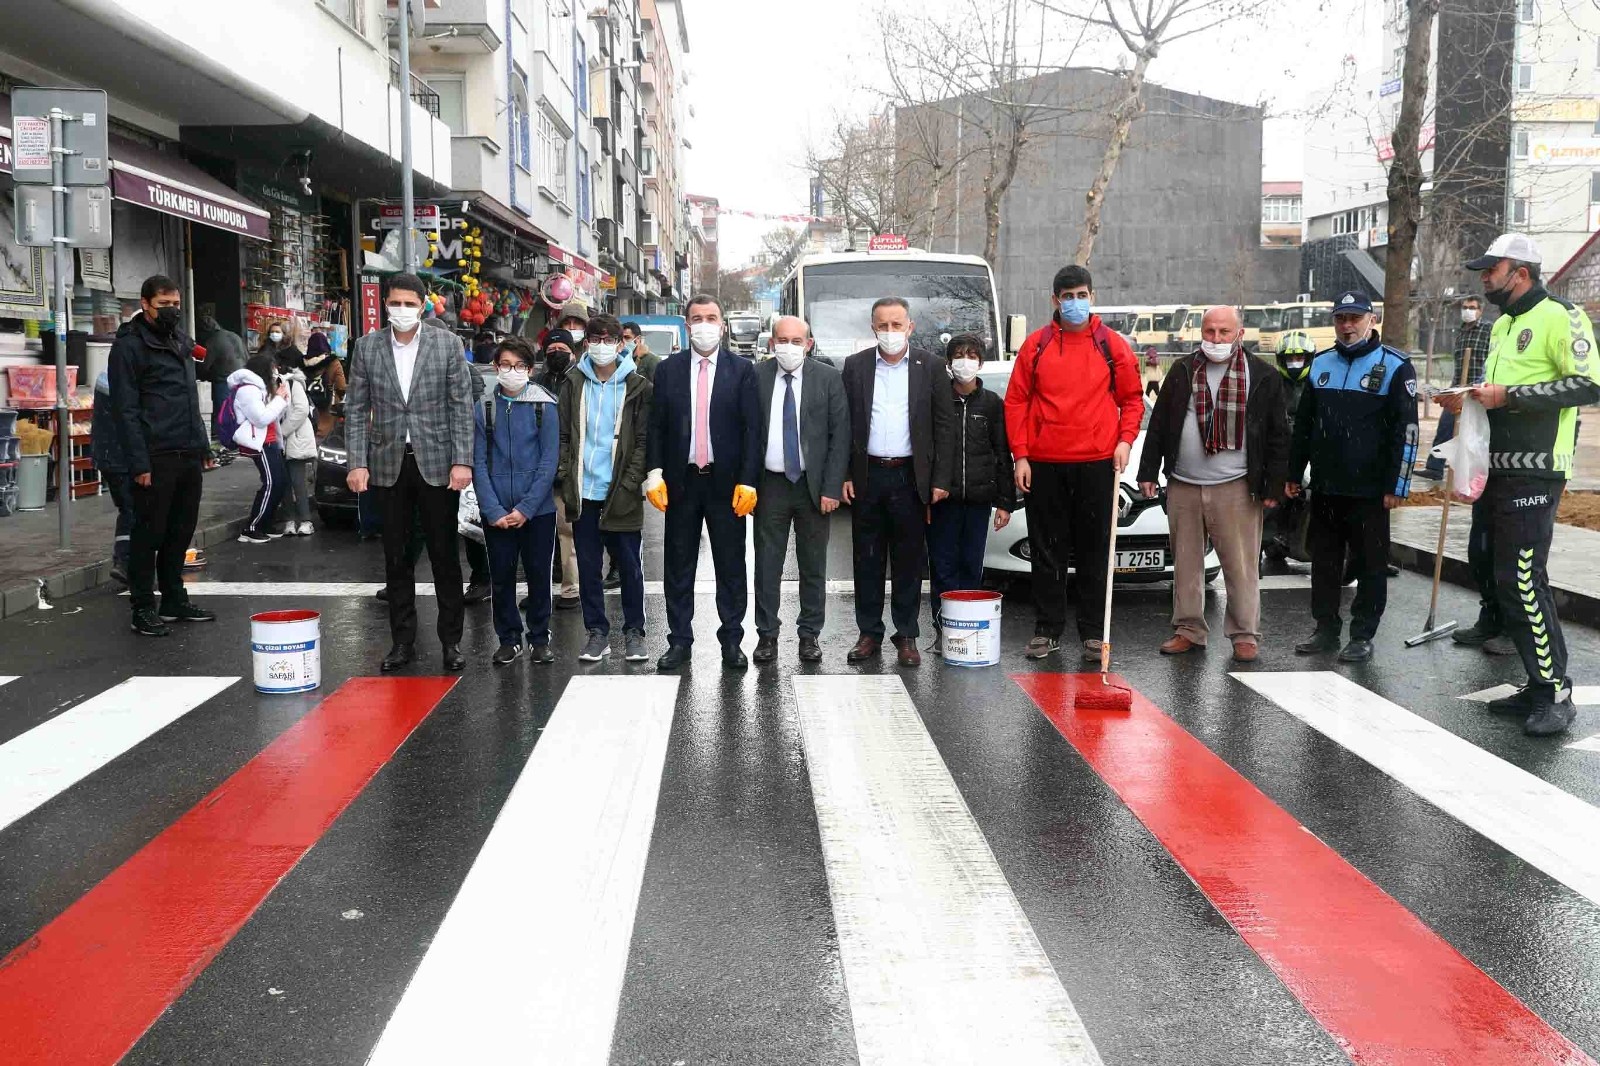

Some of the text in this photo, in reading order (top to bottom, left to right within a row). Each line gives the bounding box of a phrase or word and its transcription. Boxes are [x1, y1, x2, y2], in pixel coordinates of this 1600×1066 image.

[147, 184, 248, 229] TÜRKMEN KUNDURA
[1116, 551, 1160, 567] T 2756
